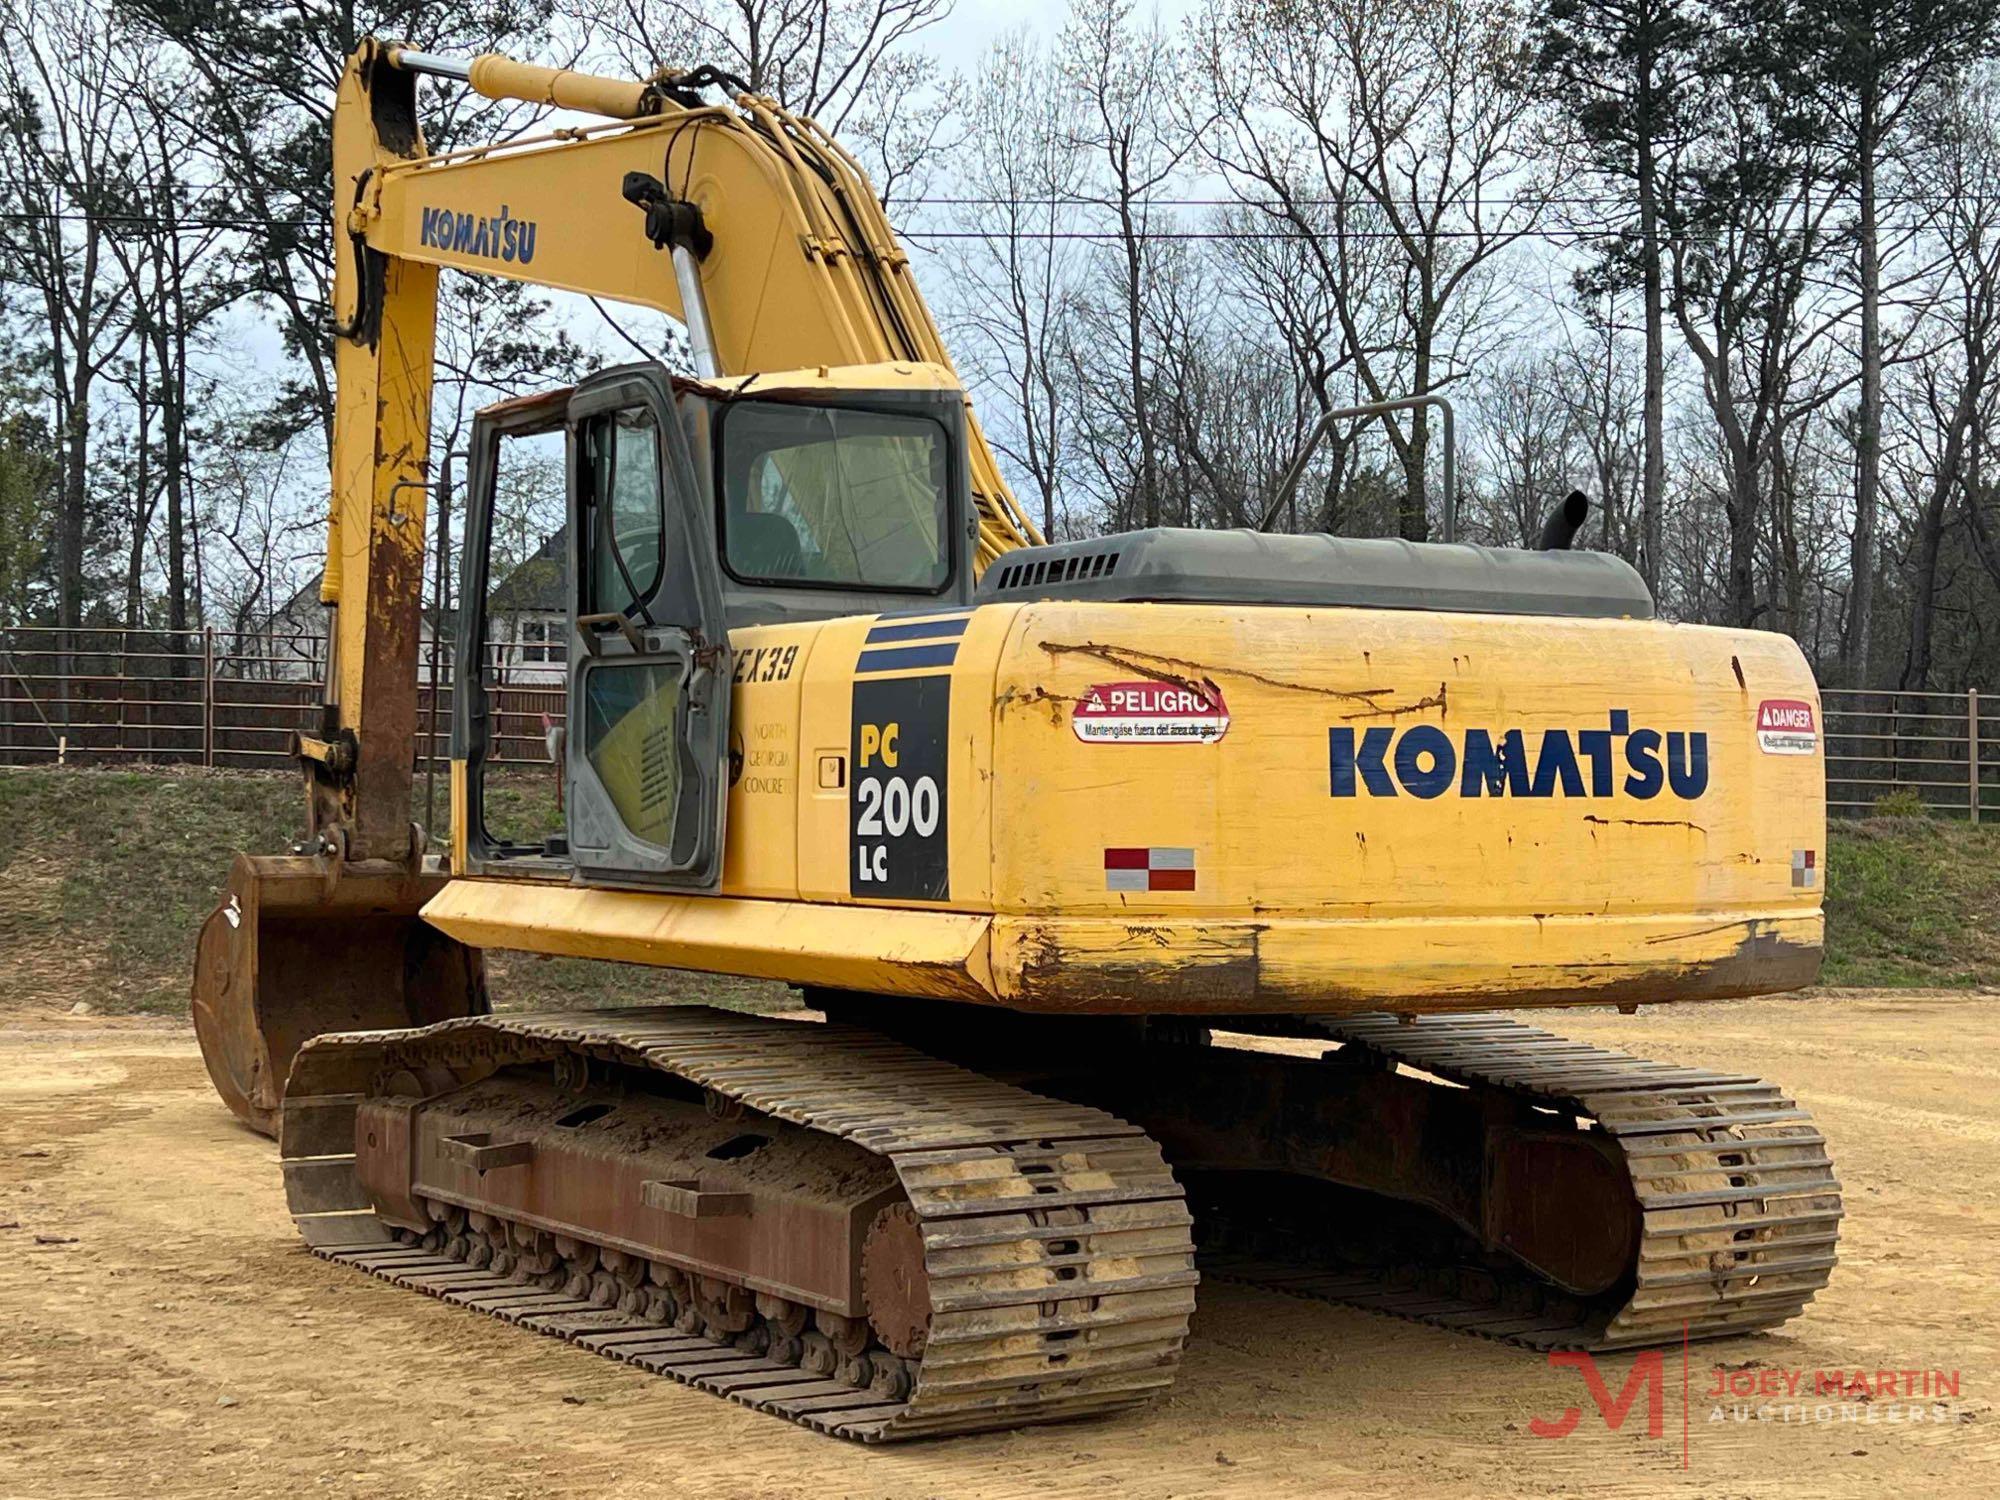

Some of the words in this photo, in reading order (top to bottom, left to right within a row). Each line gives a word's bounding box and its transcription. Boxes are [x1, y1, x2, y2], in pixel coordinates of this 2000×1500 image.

[421, 205, 537, 264] KOMATSU
[731, 646, 799, 683] EX39
[1111, 691, 1209, 712] PELIGRO
[754, 723, 787, 740] NORTH
[1157, 723, 1169, 736] del
[1772, 708, 1810, 728] DANGER
[749, 750, 790, 766] GEORGIA
[860, 723, 899, 768] PC
[1329, 710, 1709, 800] KOMATSU
[744, 777, 794, 794] CONCRE
[857, 776, 940, 837] 200
[859, 845, 888, 881] LC
